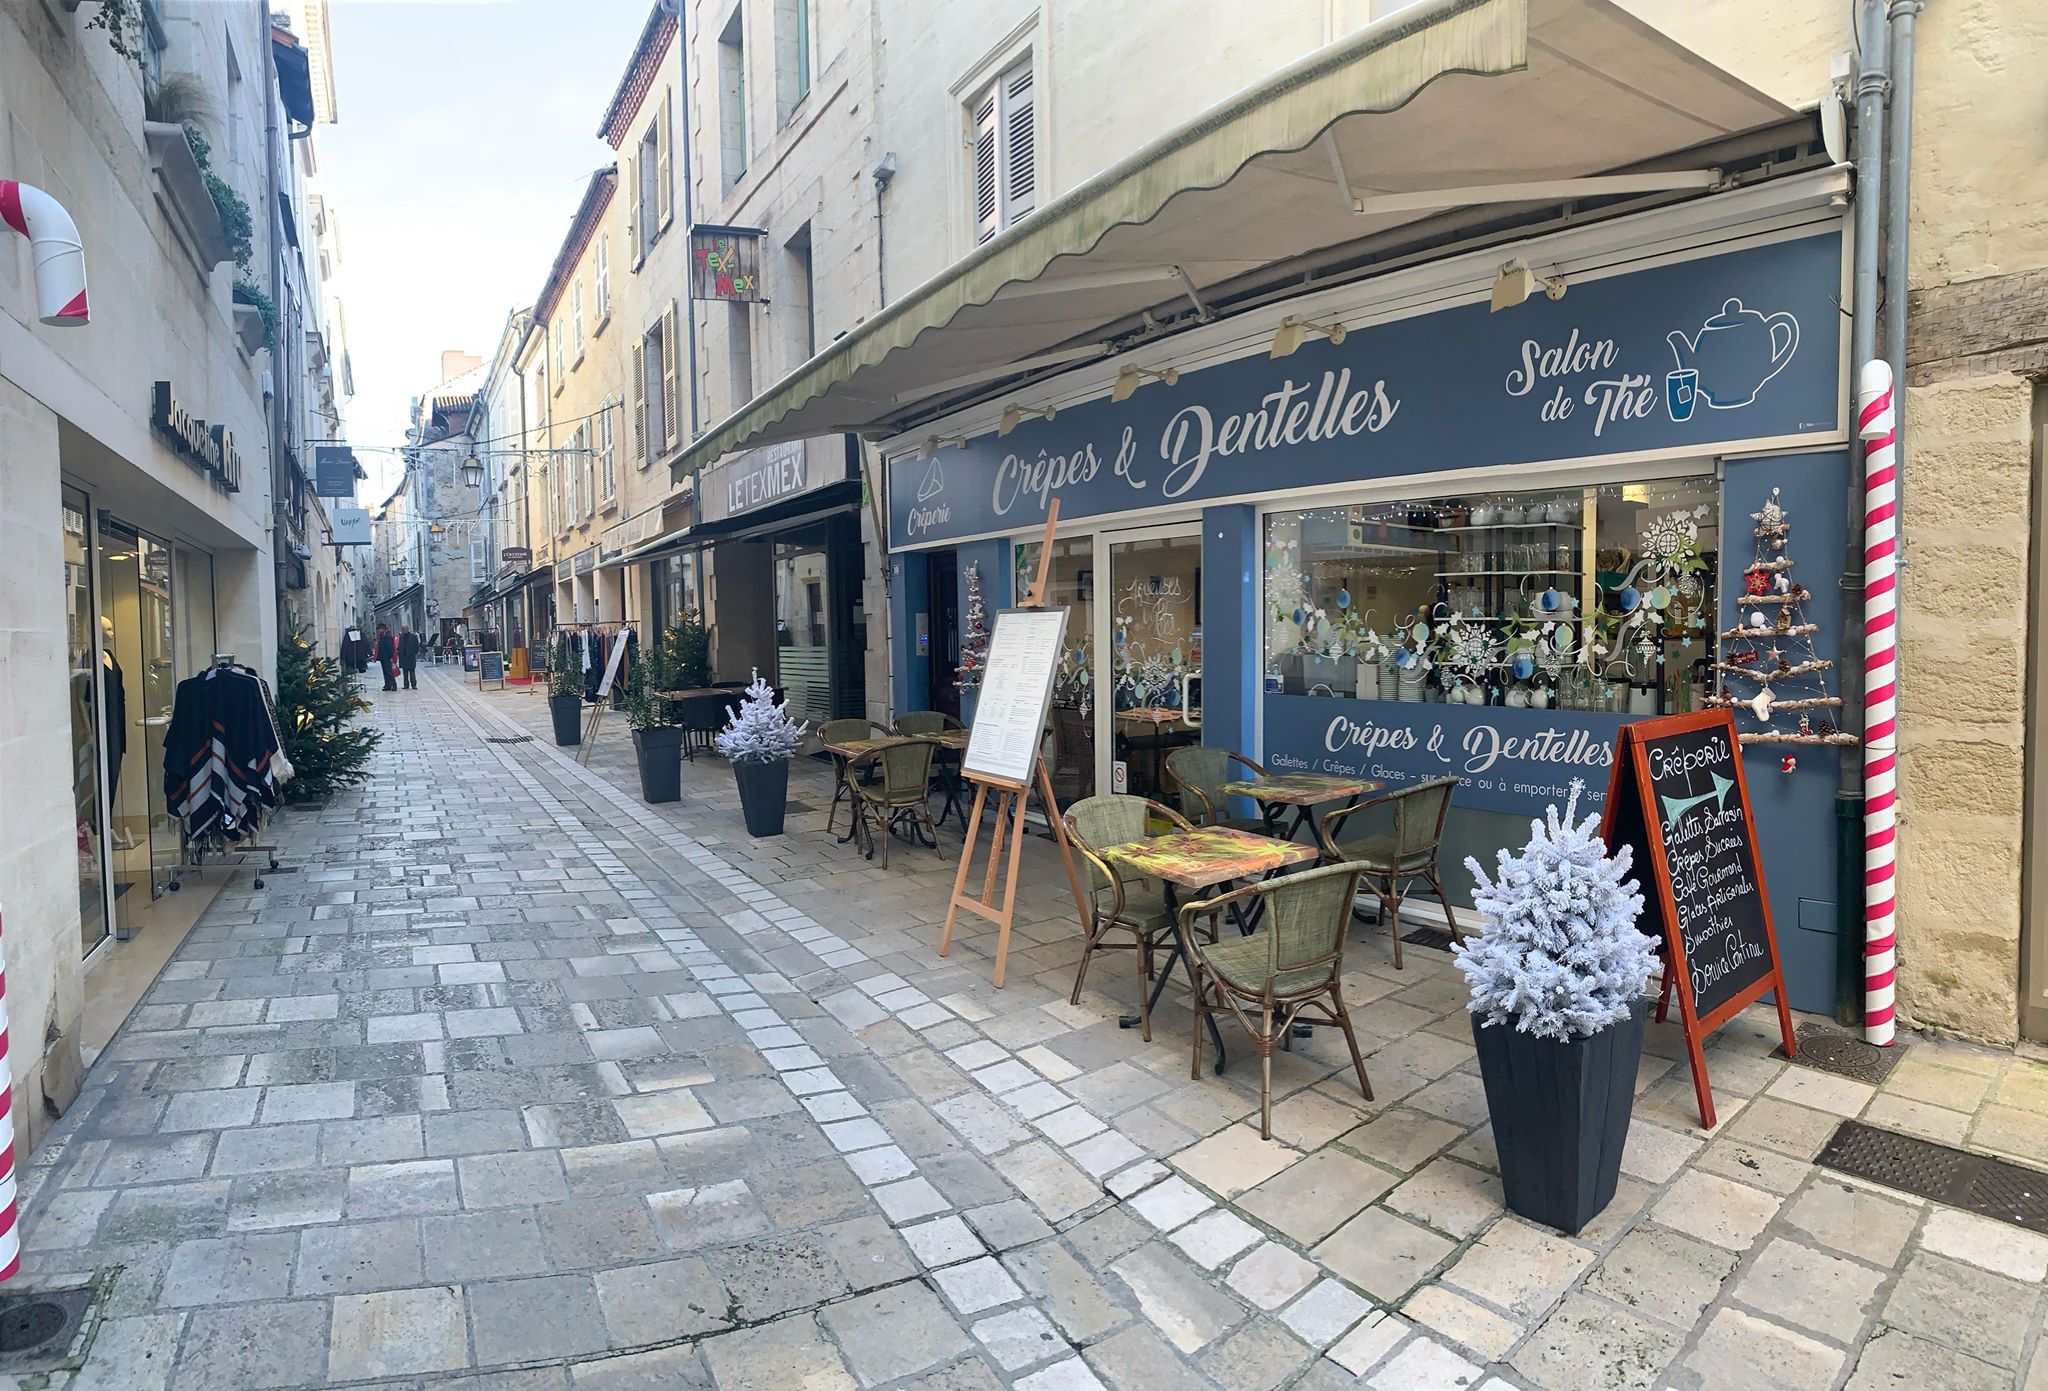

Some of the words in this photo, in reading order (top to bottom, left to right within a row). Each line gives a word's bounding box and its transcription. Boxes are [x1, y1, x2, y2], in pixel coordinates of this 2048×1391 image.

[716, 274, 754, 297] Mex
[1505, 328, 1619, 396] Salon
[157, 381, 221, 471] Jacqueline
[1541, 386, 1575, 422] de
[1584, 374, 1658, 437] Thé
[993, 443, 1102, 515] Crêpes
[1114, 426, 1147, 489] &
[1161, 367, 1401, 498] Dentelles
[907, 502, 951, 536] Crêperie
[1325, 715, 1418, 758] Crêpes
[1426, 724, 1451, 763] &
[1462, 724, 1614, 774] Dentelles
[1271, 753, 1309, 770] Galettes
[1322, 759, 1356, 776] Crêpes
[1371, 764, 1406, 781] Glaces
[1478, 779, 1493, 790] ou
[1498, 777, 1506, 792] à
[1513, 784, 1569, 799] emporter
[1587, 791, 1607, 803] ser
[1671, 872, 1698, 905] Café
[1696, 853, 1743, 892] Gourmand
[1684, 915, 1734, 960] Smoothies
